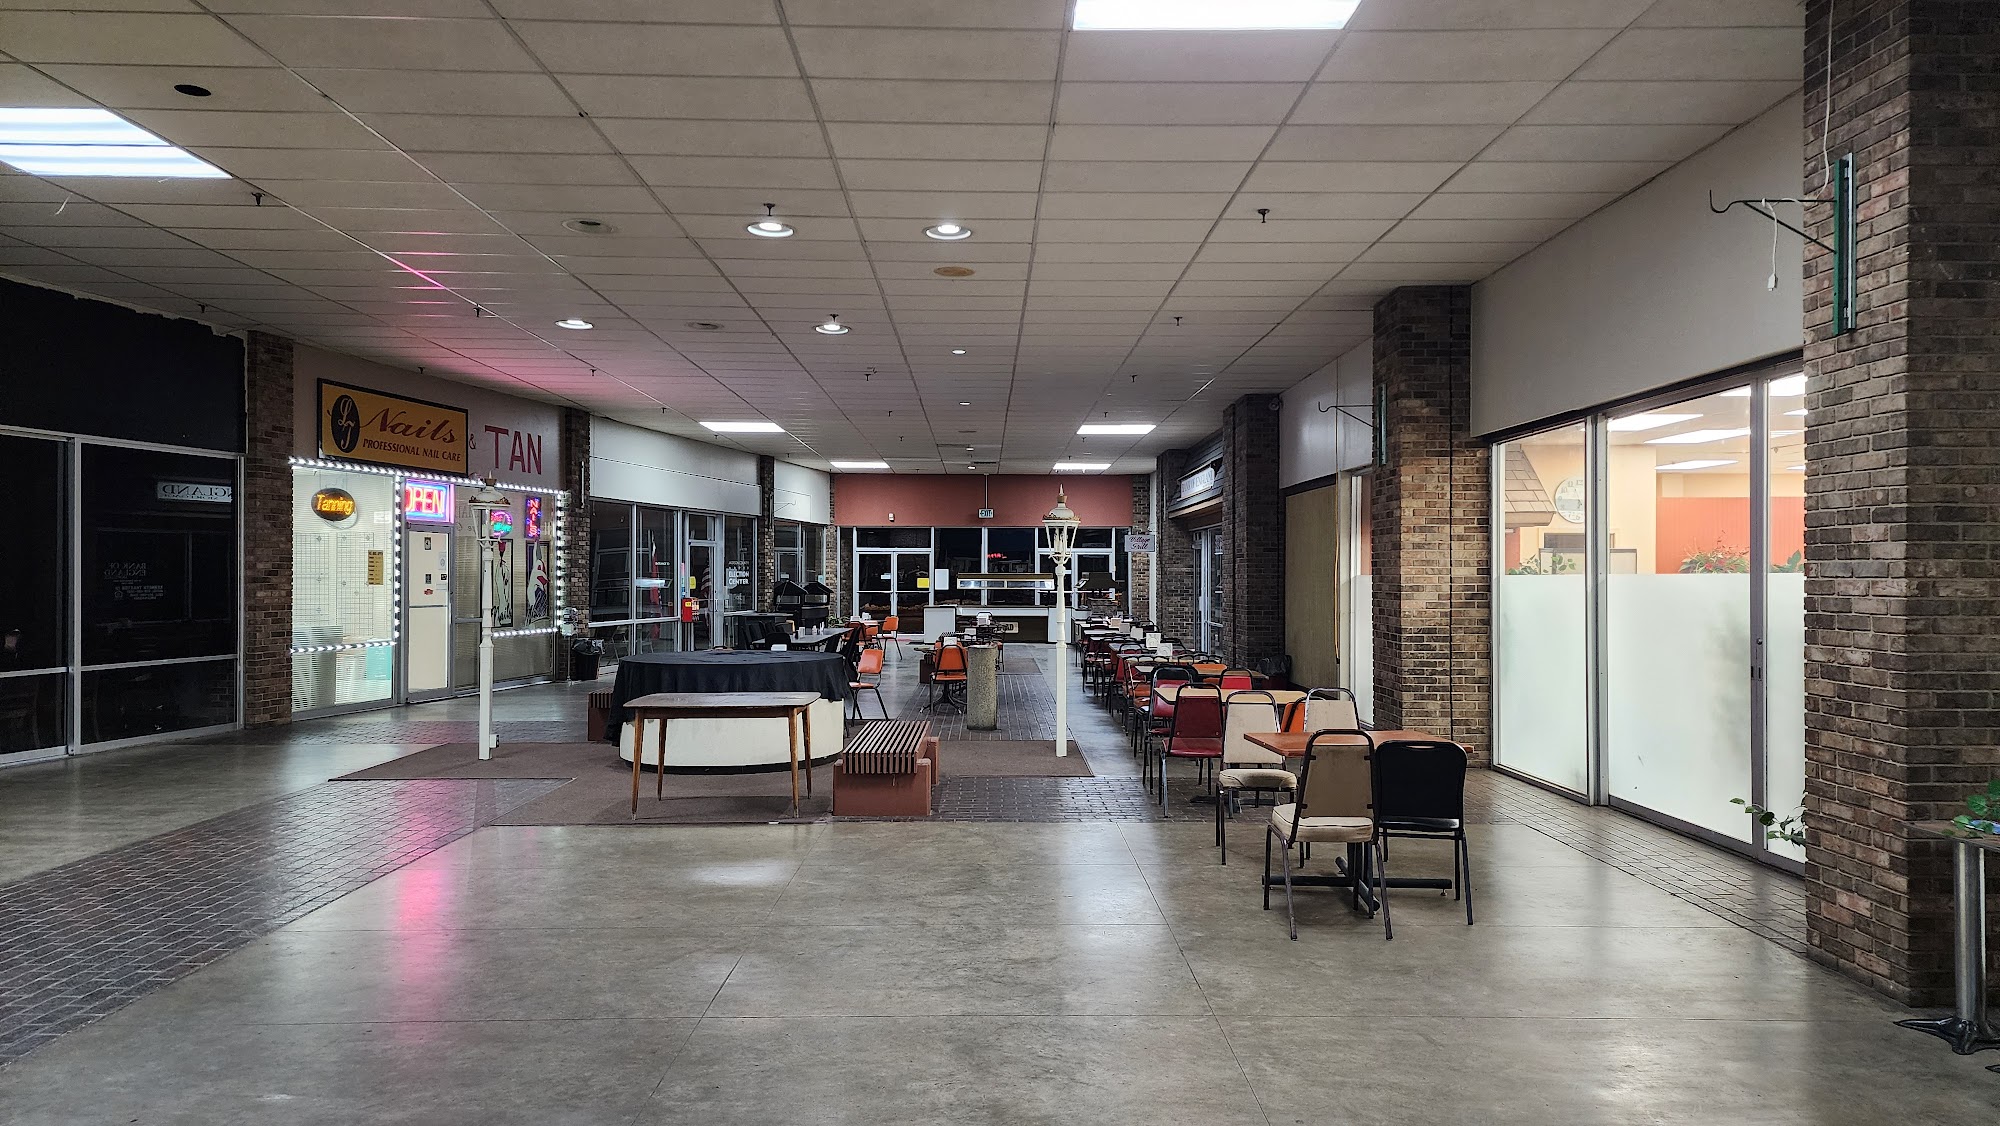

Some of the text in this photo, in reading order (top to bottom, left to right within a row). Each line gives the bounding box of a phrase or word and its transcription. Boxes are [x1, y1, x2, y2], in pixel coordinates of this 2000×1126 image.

[360, 408, 457, 443] Nails
[363, 439, 461, 462] PROFESSIONAL NAIL CARE
[469, 425, 541, 475] & TAN
[316, 494, 354, 515] Tanning
[529, 500, 538, 535] NAILS
